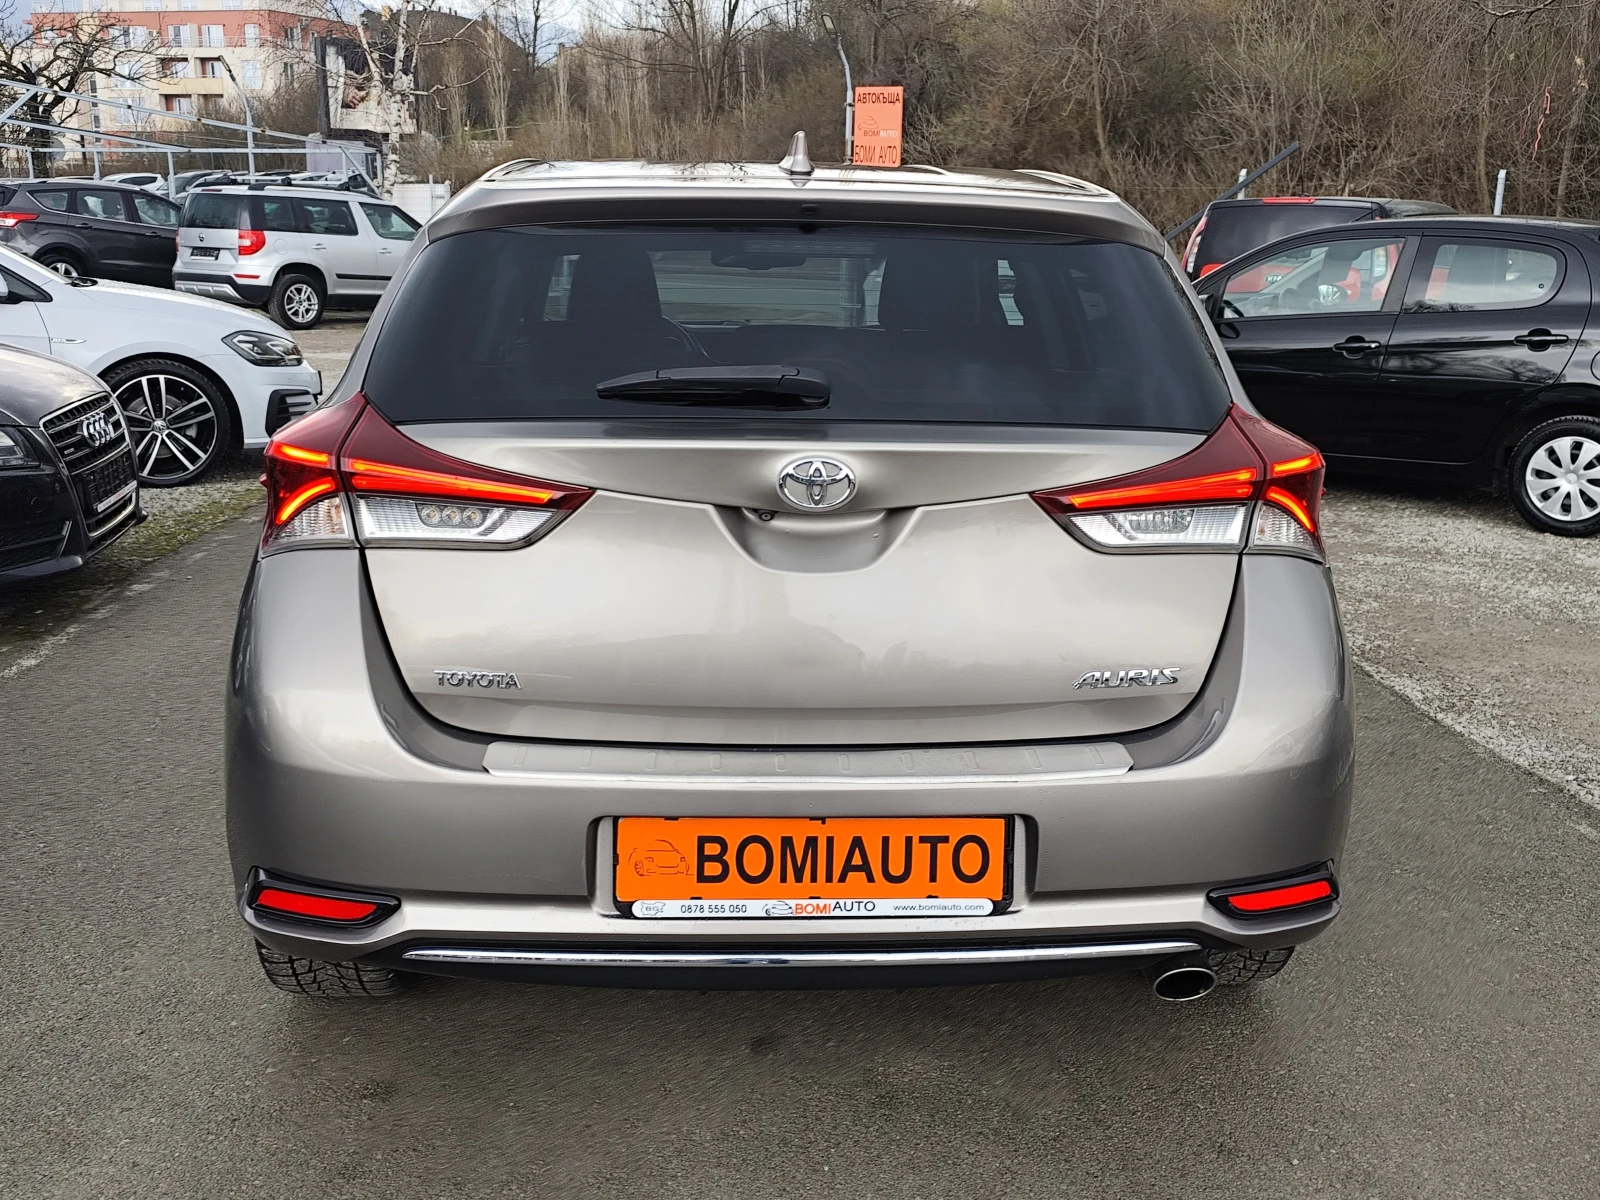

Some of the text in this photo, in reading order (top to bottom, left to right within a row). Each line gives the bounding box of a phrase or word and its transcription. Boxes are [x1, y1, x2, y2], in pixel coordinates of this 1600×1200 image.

[857, 93, 901, 105] АВТОКЪЩА
[855, 145, 897, 164] БОМИ АУТО
[434, 670, 522, 690] TOYOTA
[1072, 667, 1181, 690] AURIS
[695, 834, 990, 884] BOMIAUTO
[681, 904, 747, 914] 0878 555 050
[893, 903, 984, 911] www.bomiauto.com
